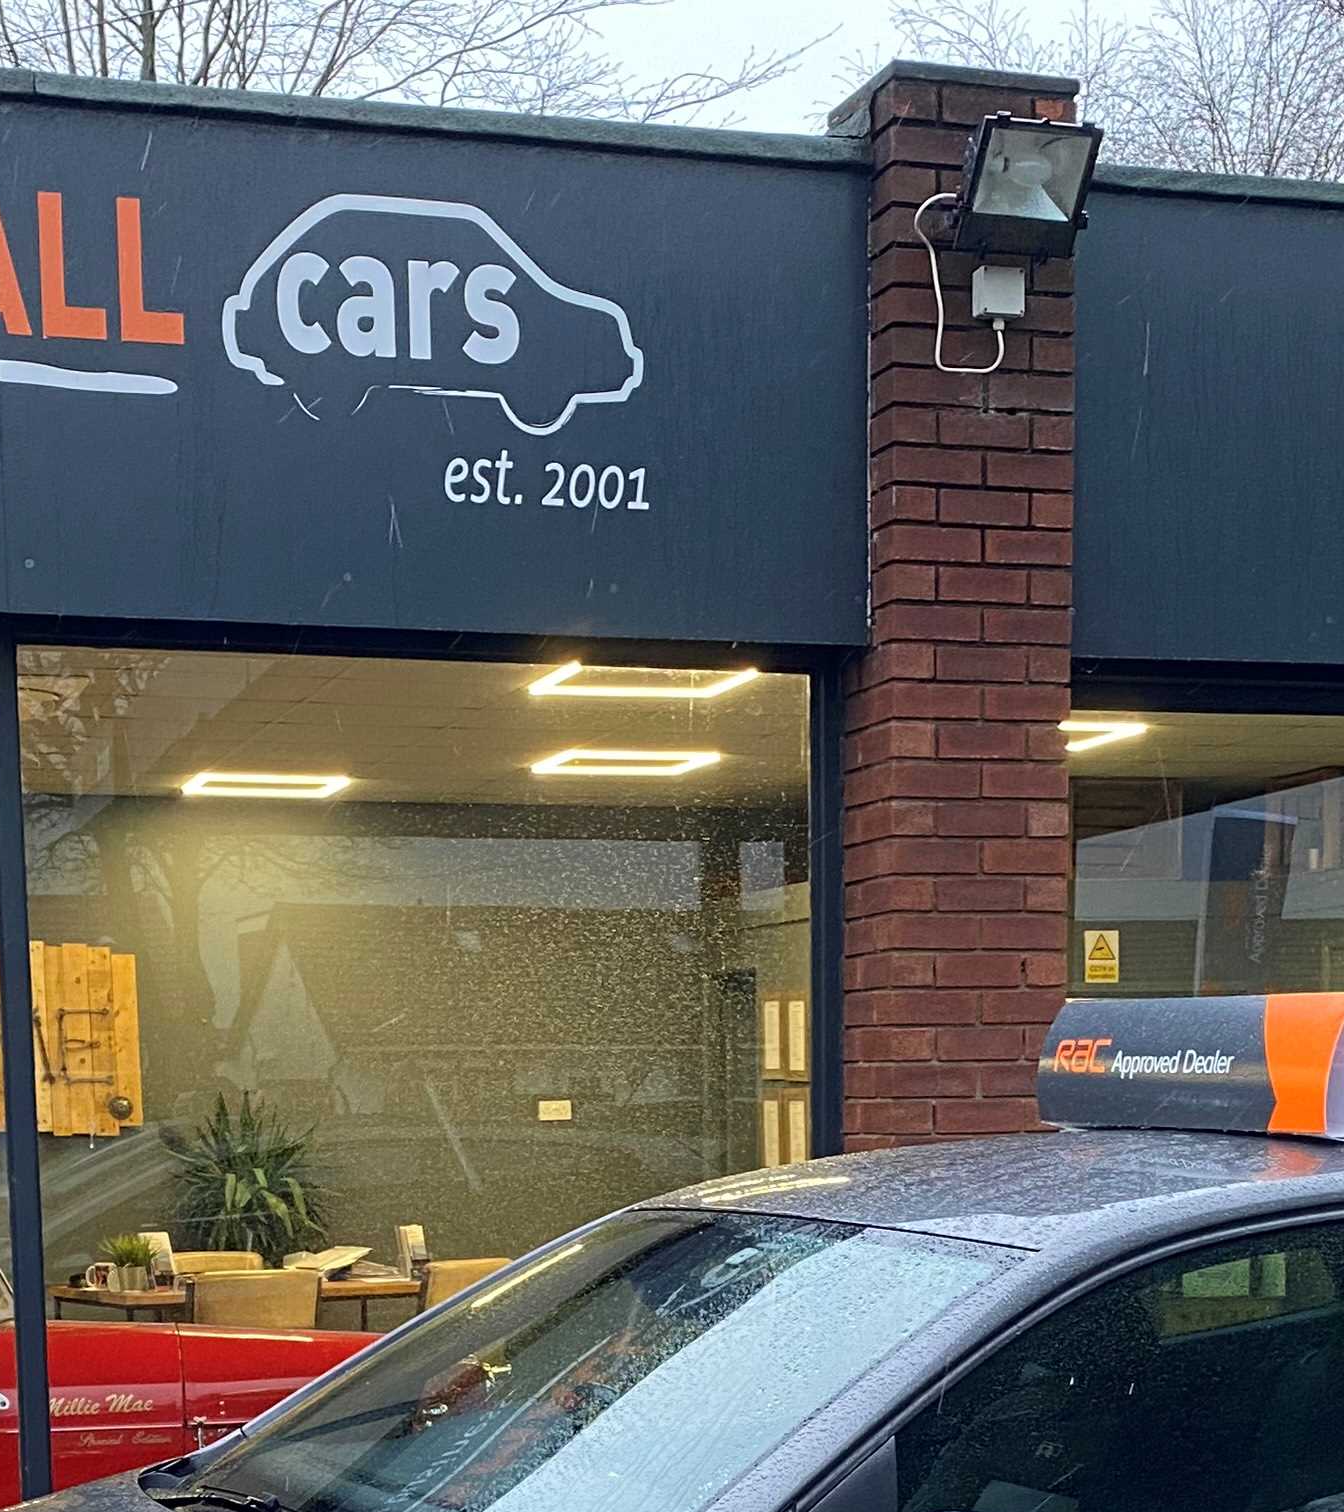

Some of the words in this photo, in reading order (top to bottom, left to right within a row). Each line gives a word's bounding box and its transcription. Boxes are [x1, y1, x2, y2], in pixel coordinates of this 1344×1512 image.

[275, 250, 521, 365] cars
[443, 449, 524, 505] est.
[541, 460, 651, 511] 2001
[1111, 1048, 1182, 1080] Approved
[1182, 1049, 1235, 1075] Dealer
[105, 1394, 154, 1413] Mae
